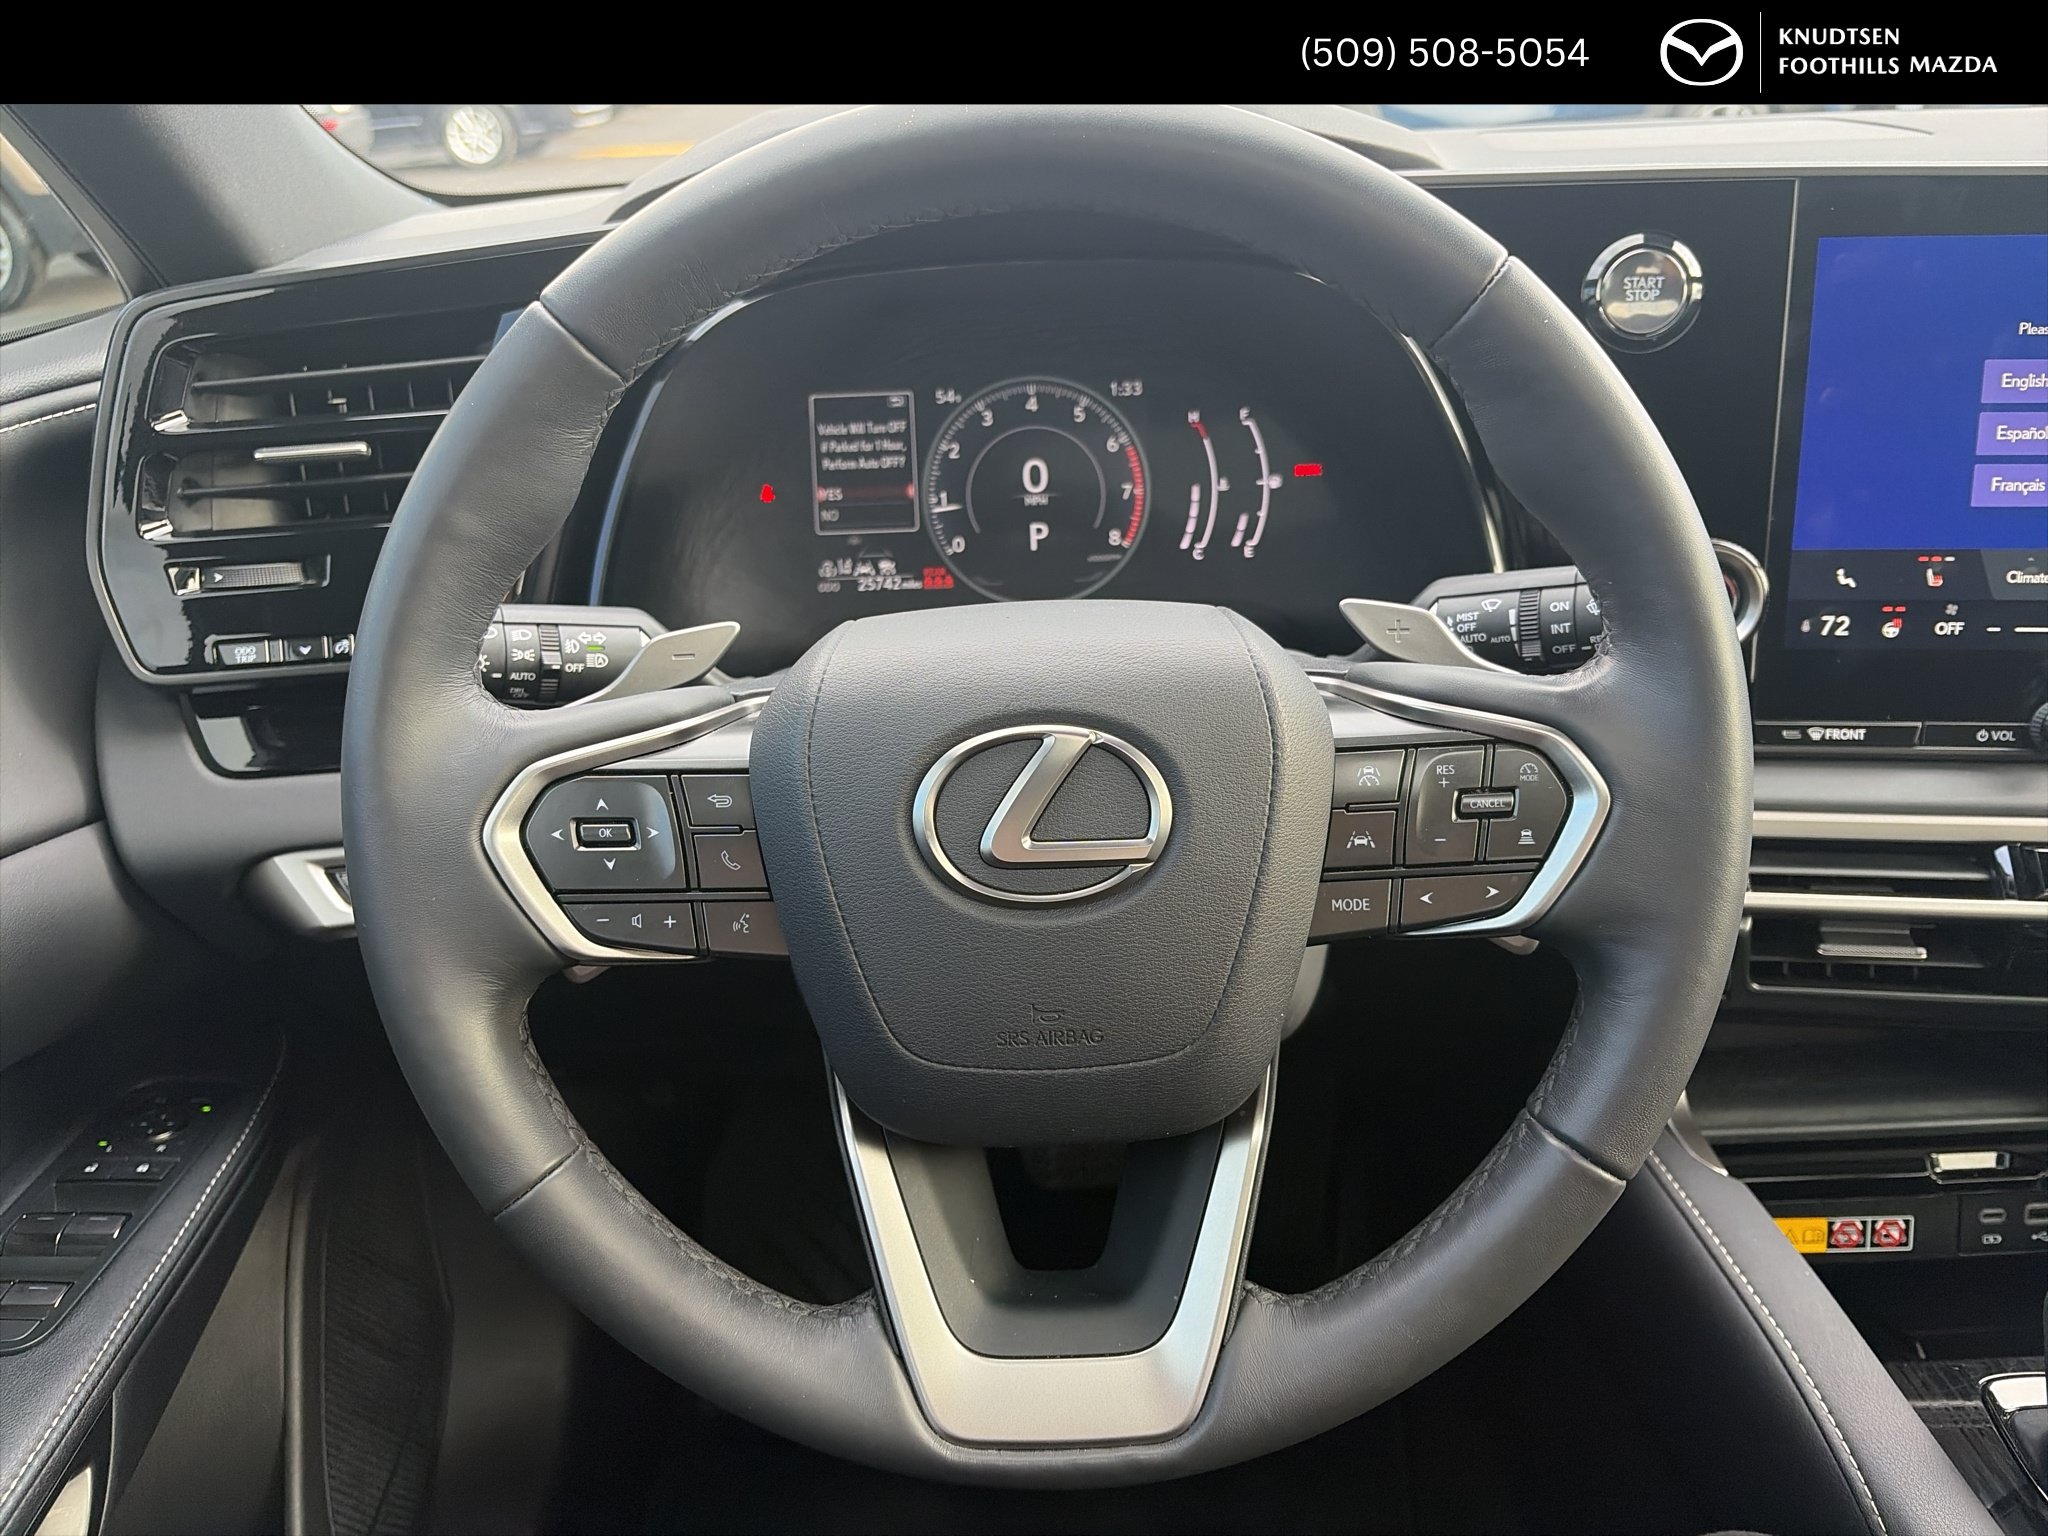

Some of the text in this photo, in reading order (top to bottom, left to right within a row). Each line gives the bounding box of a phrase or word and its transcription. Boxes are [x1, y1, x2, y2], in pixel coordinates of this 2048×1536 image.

[1623, 276, 1665, 290] START
[1625, 289, 1661, 302] STOP
[1110, 380, 1144, 396] 1:33
[1025, 396, 1040, 412] 4
[980, 409, 994, 427] 3
[1073, 406, 1087, 423] 5
[948, 442, 961, 459] 2
[1107, 436, 1120, 453] 6
[1021, 457, 1050, 494] 0
[1120, 482, 1134, 500] 7
[1991, 476, 2046, 496] Français
[1028, 521, 1050, 552] P
[1108, 528, 1122, 546] 8
[951, 535, 966, 553] 0
[1549, 601, 1570, 612] ON
[1456, 611, 1479, 622] MIST
[1456, 623, 1476, 633] OFF
[1550, 622, 1572, 635] INT
[1820, 615, 1850, 637] 72
[1934, 621, 1965, 636] OFF
[1460, 632, 1511, 644] AUTO AUTO
[1551, 643, 1577, 655] OFF
[564, 662, 585, 673] OFF
[509, 671, 537, 682] AUTO
[1824, 728, 1867, 742] FRONT
[1990, 730, 2017, 742] VOL
[1436, 764, 1456, 776] RES
[1519, 774, 1541, 782] MODE
[1469, 799, 1506, 809] CANCEL
[598, 827, 614, 838] OK
[1331, 898, 1371, 912] MODE
[996, 1028, 1105, 1048] SRS AIRBAG
